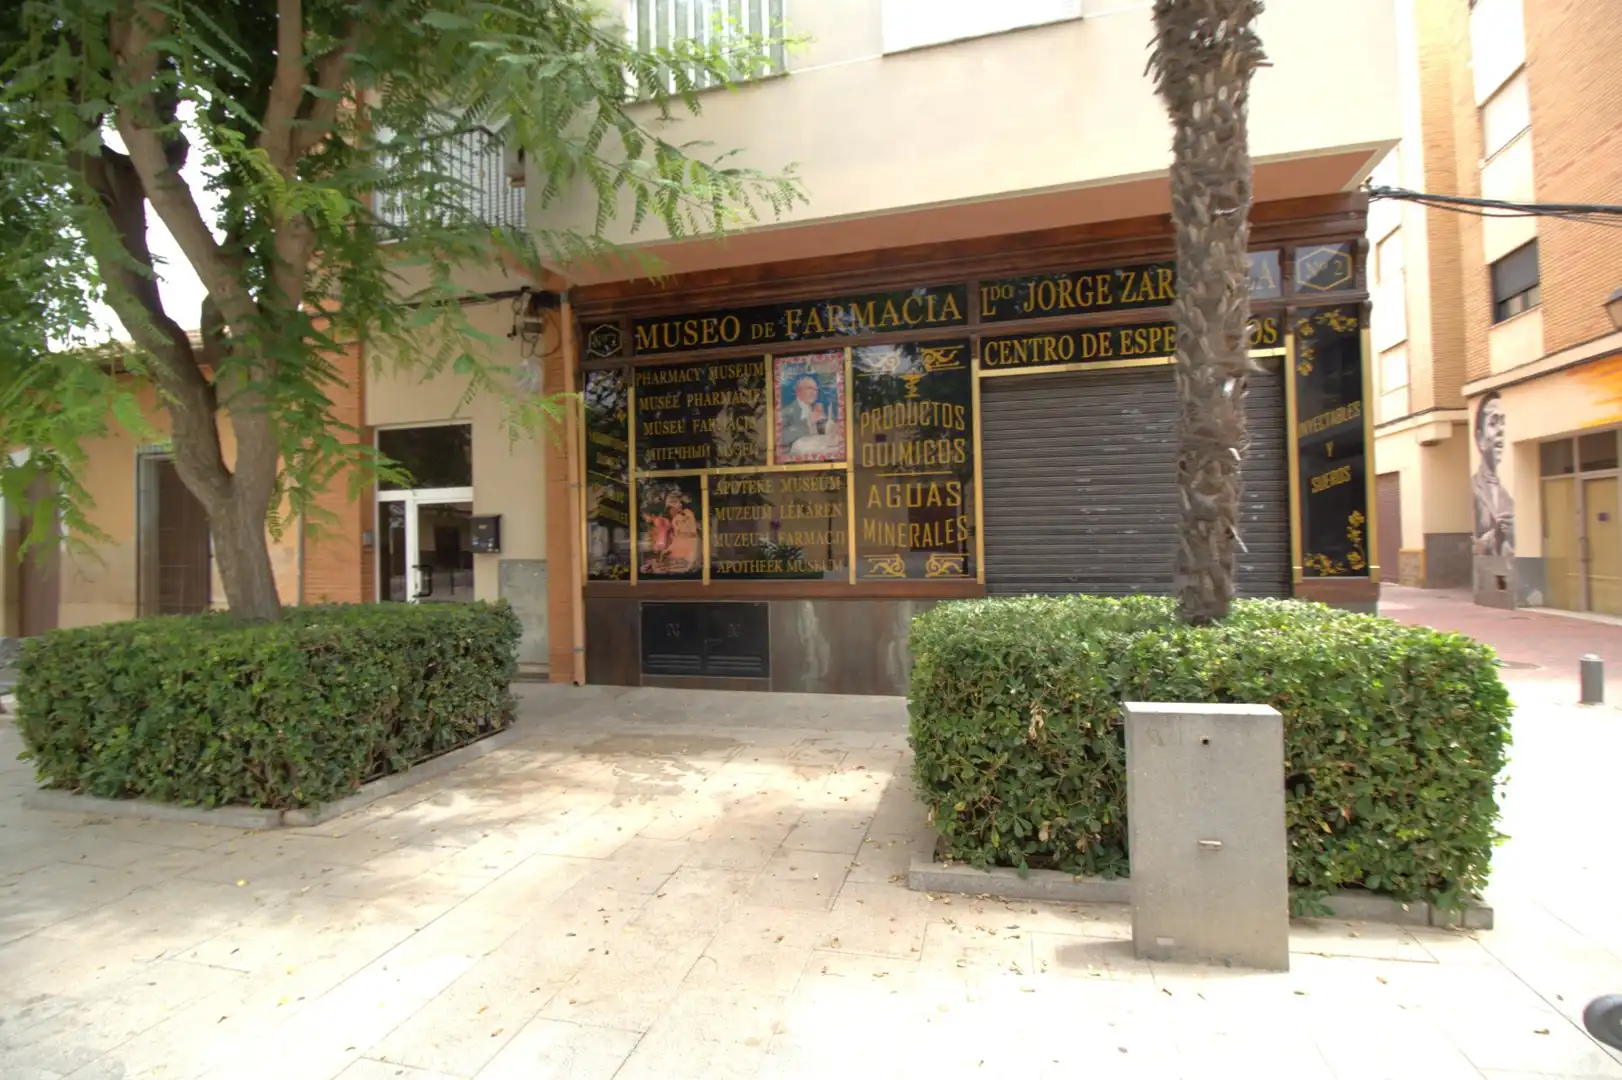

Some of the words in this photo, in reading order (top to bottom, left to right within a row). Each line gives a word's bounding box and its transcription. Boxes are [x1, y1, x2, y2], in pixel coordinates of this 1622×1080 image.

[1333, 259, 1344, 277] 2
[1023, 273, 1113, 313] JORGE
[635, 315, 741, 350] MUSEO
[751, 322, 776, 340] DE
[784, 291, 963, 336] FARMACIA
[984, 334, 1075, 367] CENTRO
[1081, 331, 1113, 359] DE
[635, 367, 702, 386] PHARMACY
[708, 361, 764, 381] MUSEUM
[860, 401, 965, 436] PRODUCTOS
[861, 438, 966, 468] QUIMICOS
[1325, 440, 1335, 458] Y
[781, 476, 841, 492] MUSEUM
[867, 481, 961, 509] AGUAS
[715, 505, 772, 521] MUZEUM
[863, 514, 969, 548] MINERALES
[716, 560, 783, 574] APOTHEEK
[787, 558, 844, 573] MUSEUM
